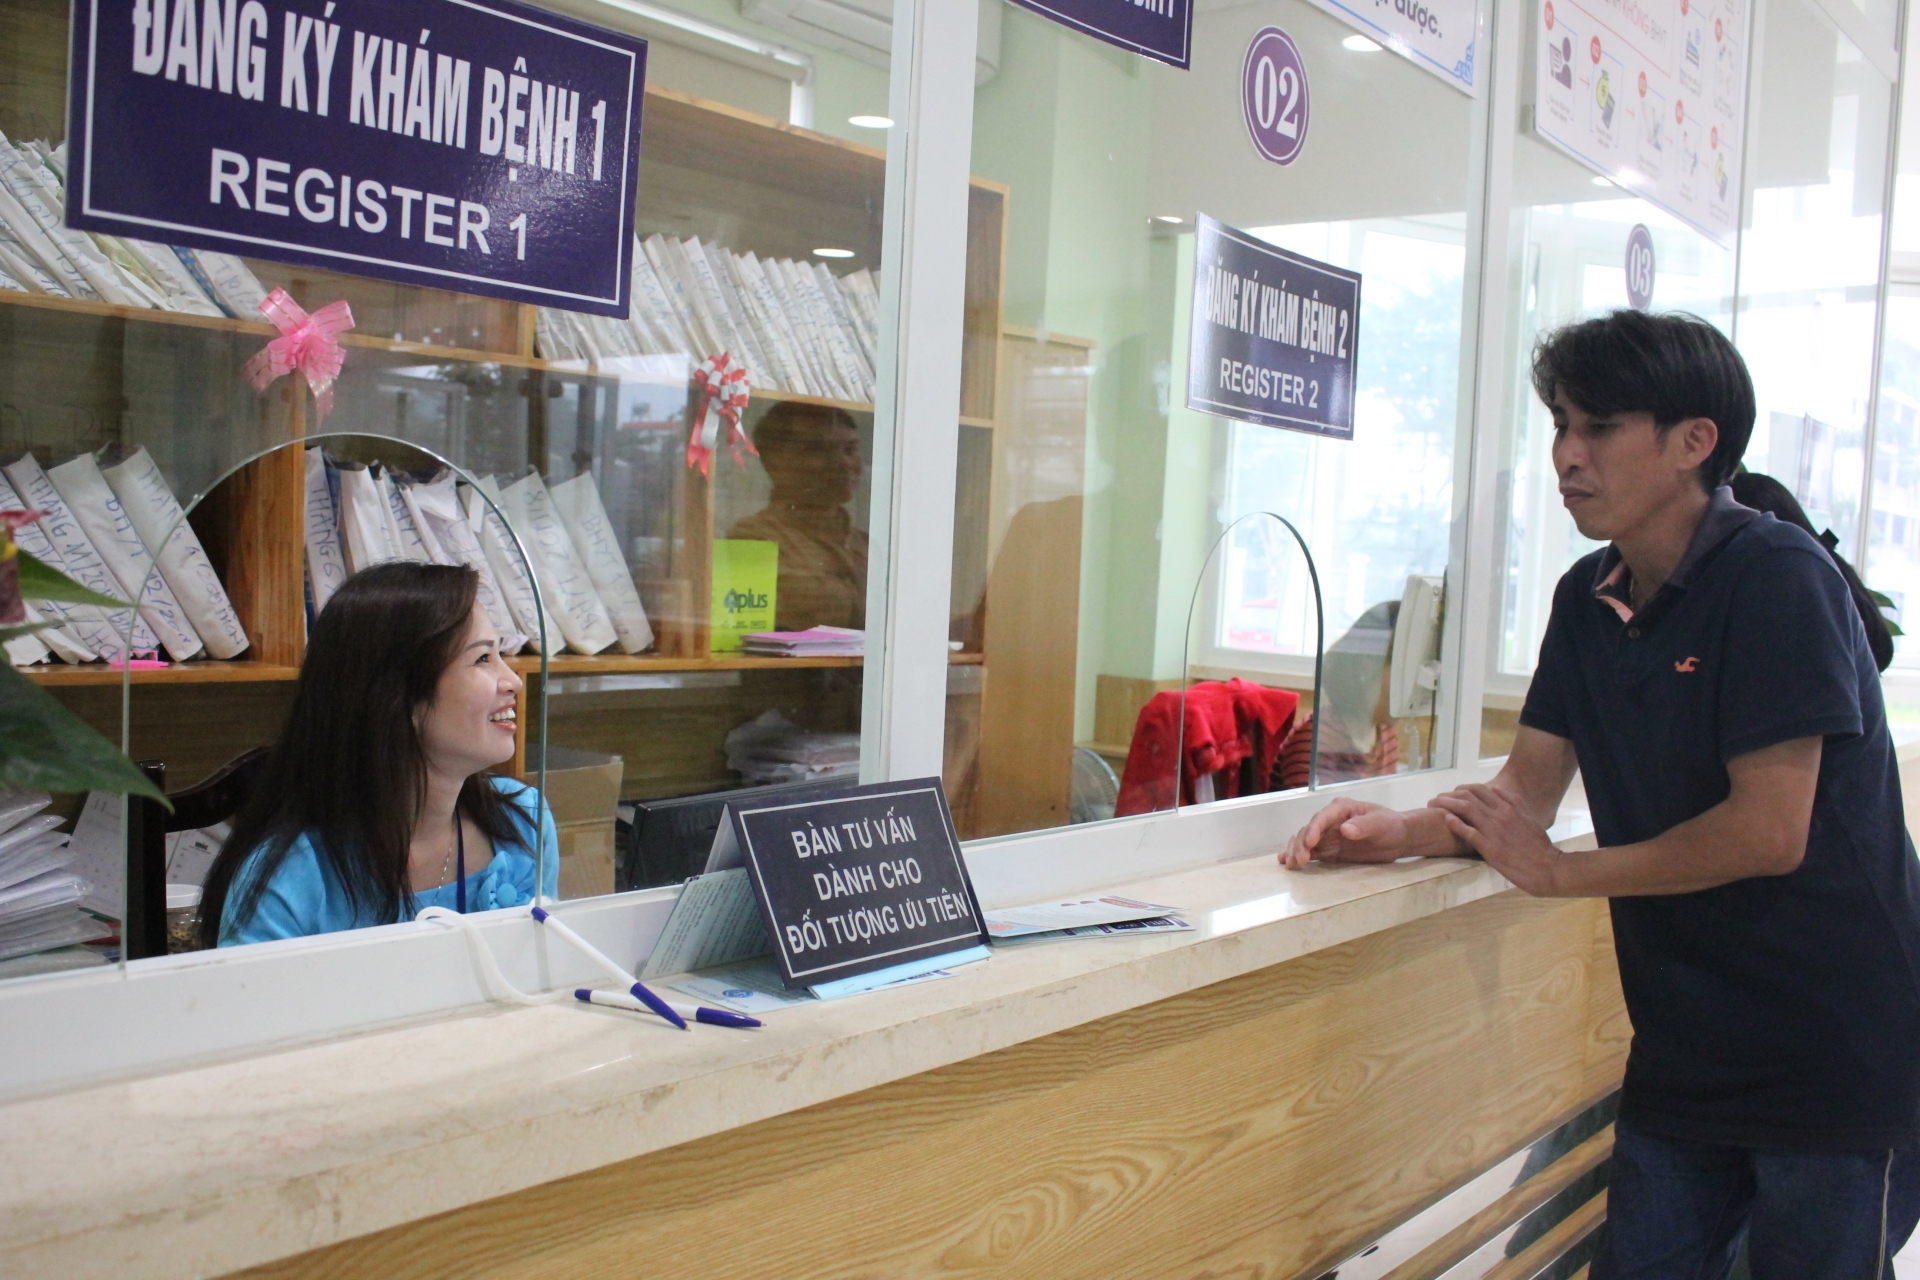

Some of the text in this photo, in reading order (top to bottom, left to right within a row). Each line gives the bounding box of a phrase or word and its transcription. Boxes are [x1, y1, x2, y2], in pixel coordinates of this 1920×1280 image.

[280, 1, 341, 117] KÝ
[350, 28, 471, 150] KHÁM
[480, 56, 580, 182] BỆNH
[592, 100, 607, 181] 1
[1255, 56, 1299, 140] 02
[210, 148, 528, 261] REGISTER 1
[1630, 243, 1651, 297] 03
[1206, 256, 1349, 363] ĐĂNG KÝ KHÁM BỆNH 2
[1220, 357, 1319, 409] REGISTER 2
[791, 806, 917, 859] BÀN TƯ VẤN
[813, 857, 922, 901] DÀNH CHO
[785, 908, 828, 954] ĐỐI
[827, 906, 899, 945] TƯỢNG
[899, 897, 927, 930] ƯU
[926, 887, 970, 923] TIÊN
